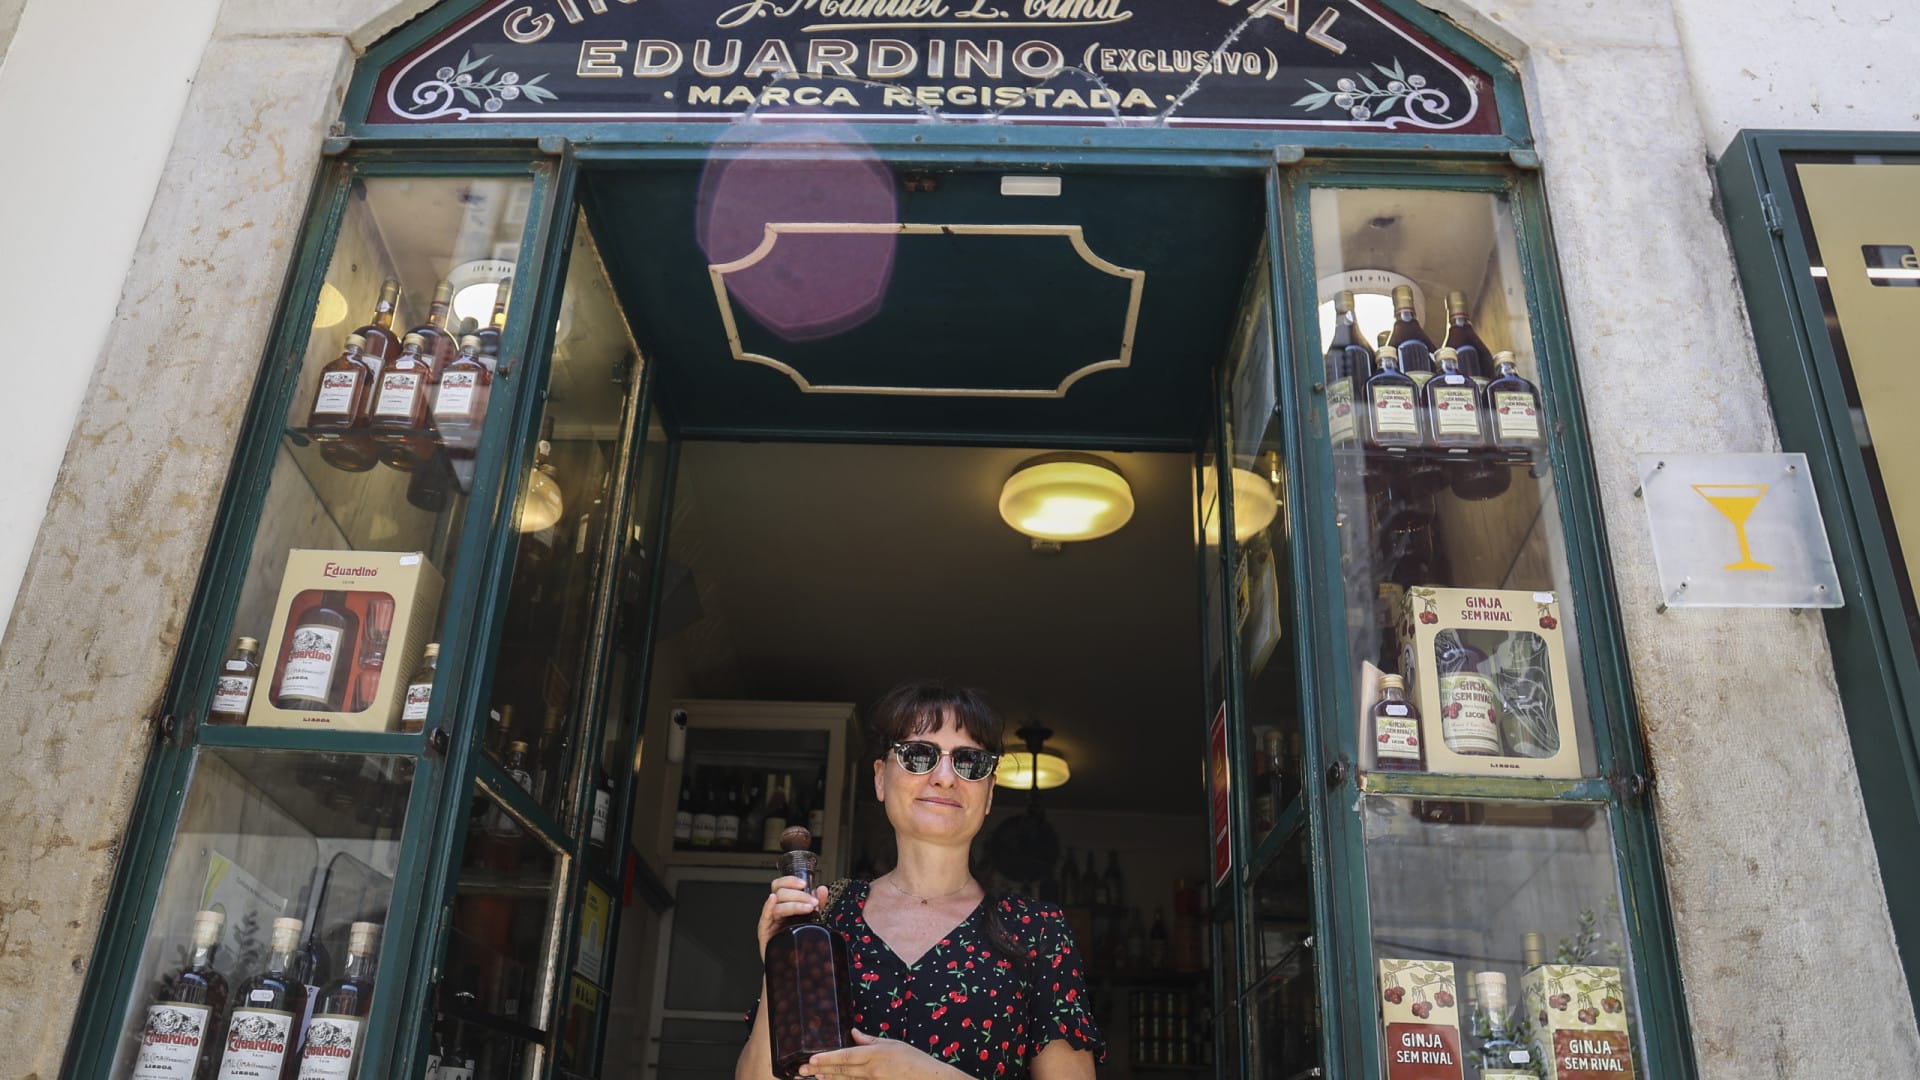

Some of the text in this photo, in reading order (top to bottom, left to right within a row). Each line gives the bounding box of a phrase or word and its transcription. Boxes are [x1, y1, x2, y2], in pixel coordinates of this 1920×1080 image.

[577, 39, 1278, 81] EDUARDINO (EXCLUSIVO)
[687, 85, 1156, 109] MARCA REGISTADA
[323, 562, 378, 578] Eduardino
[1465, 596, 1503, 609] GINJA
[1461, 610, 1512, 622] SEM RIVAL
[227, 1032, 284, 1054] Eduardino
[1402, 1032, 1443, 1049] GINJA
[1569, 1039, 1612, 1055] GINJA
[1396, 1050, 1453, 1065] SEM RIVAL
[1564, 1057, 1624, 1072] SEM RIVAL
